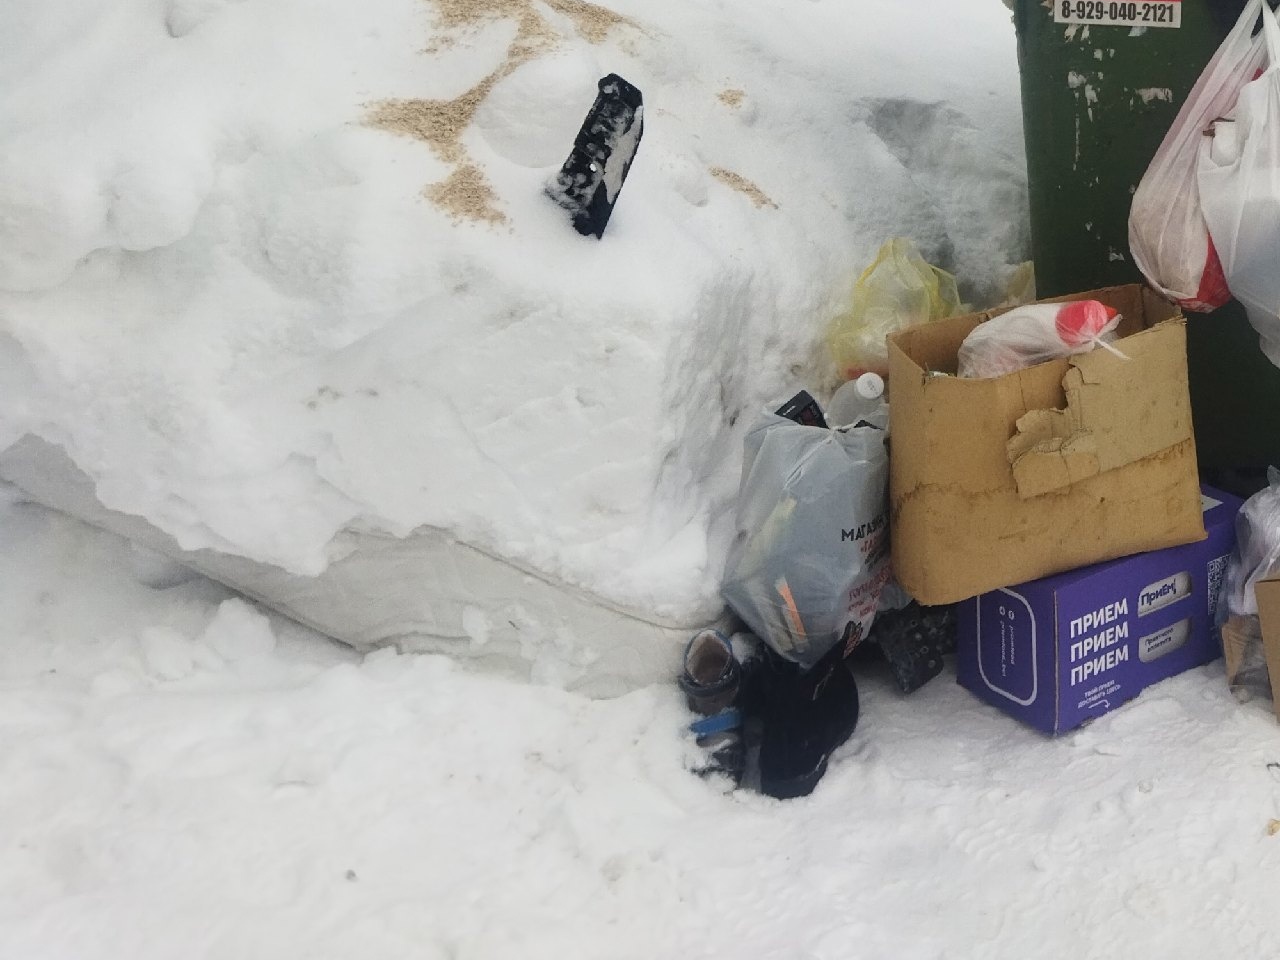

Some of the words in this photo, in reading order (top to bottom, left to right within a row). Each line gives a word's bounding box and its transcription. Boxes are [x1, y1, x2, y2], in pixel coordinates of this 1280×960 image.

[1061, 0, 1174, 22] 8-929-040-2121
[1070, 597, 1129, 639] ПРИЕМ
[1070, 621, 1129, 663] ПРИЕМ
[1070, 644, 1129, 687] ПРИЕМ
